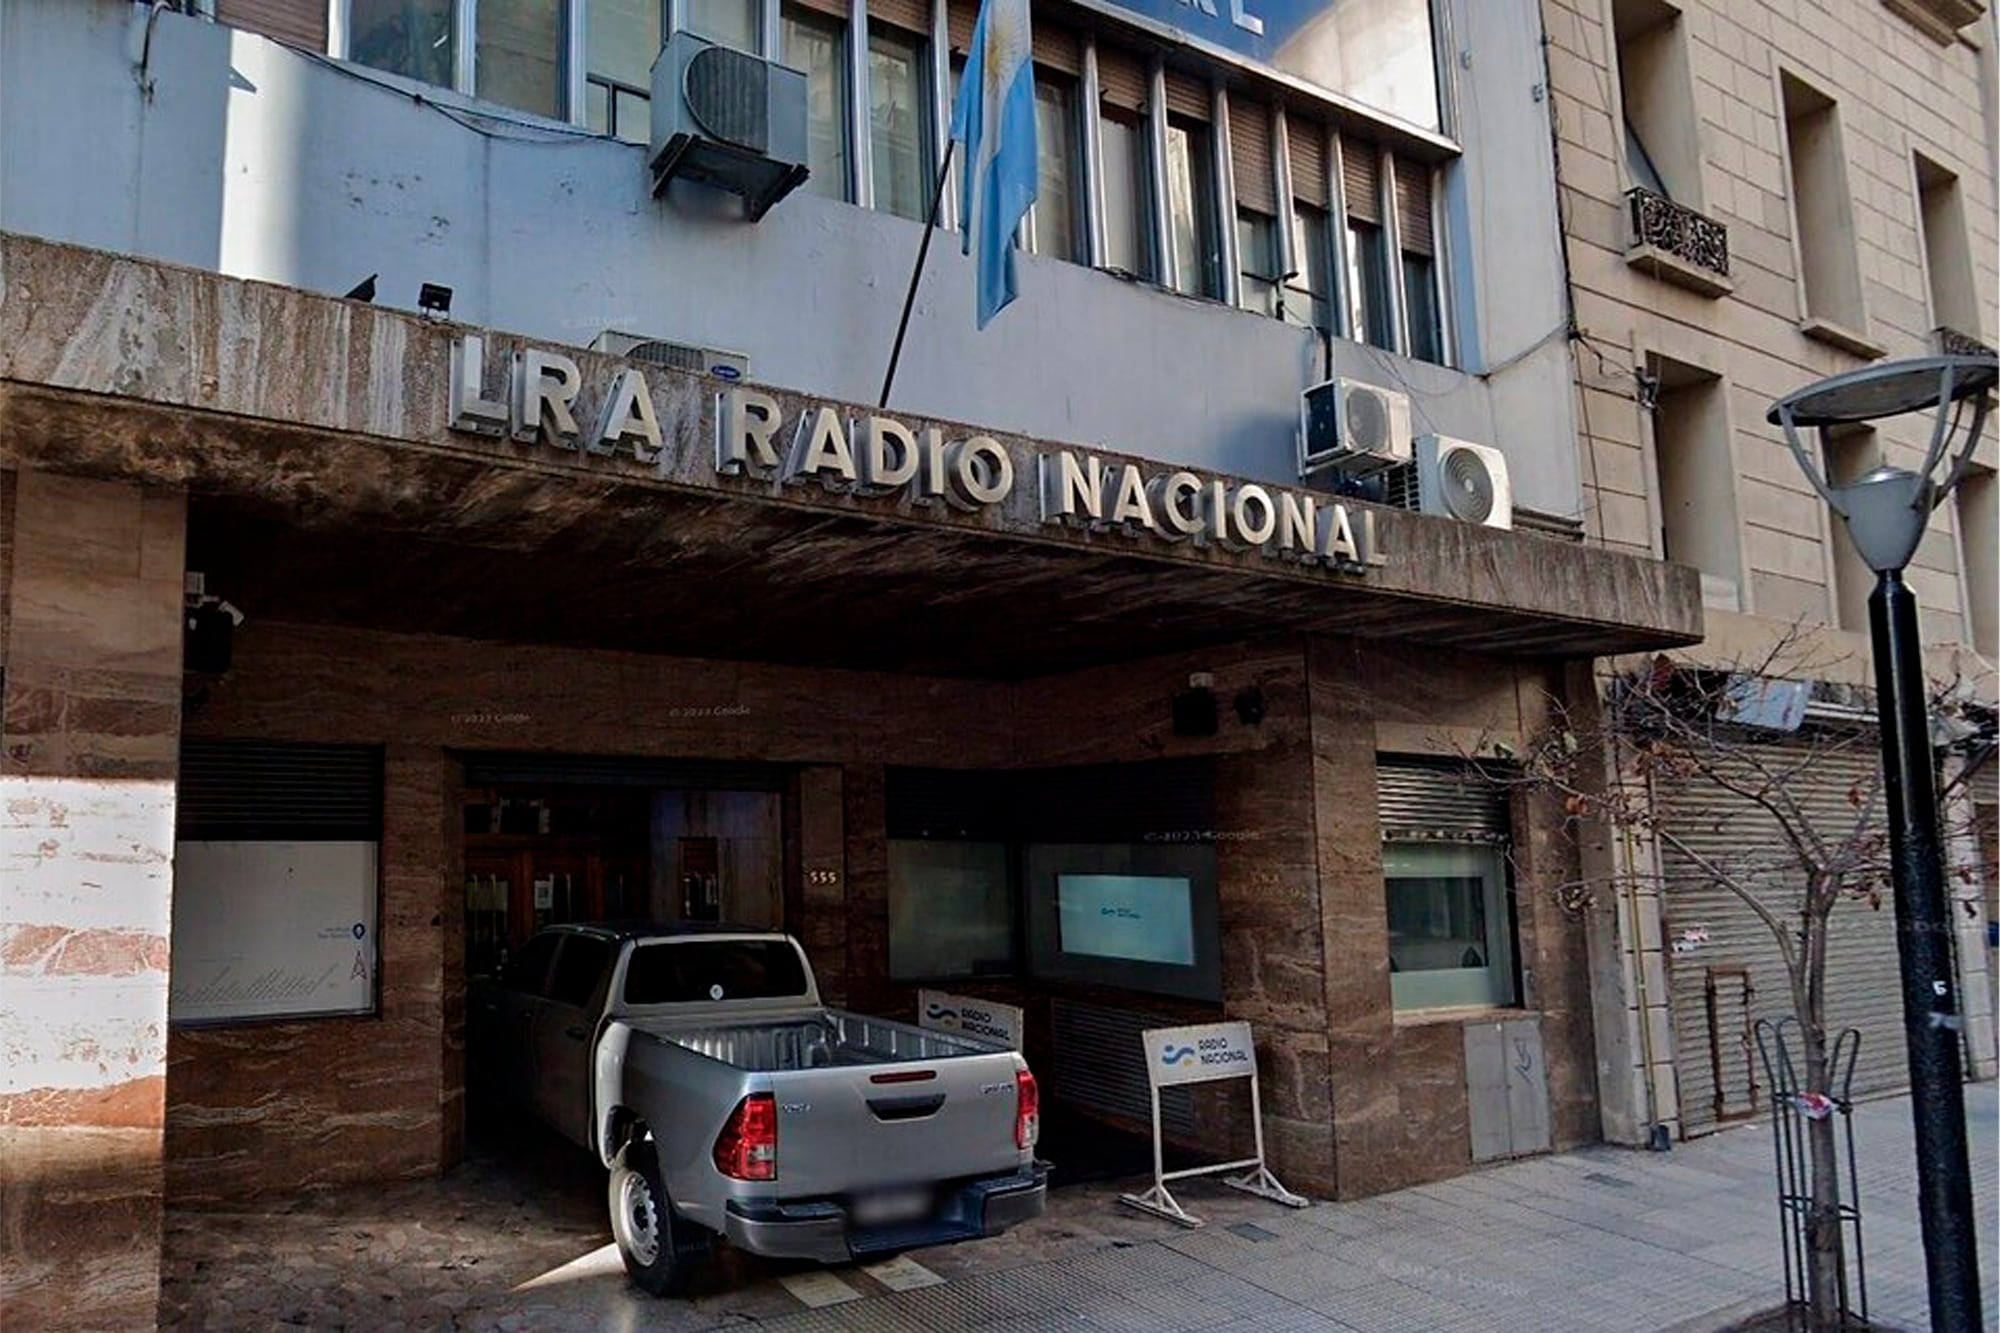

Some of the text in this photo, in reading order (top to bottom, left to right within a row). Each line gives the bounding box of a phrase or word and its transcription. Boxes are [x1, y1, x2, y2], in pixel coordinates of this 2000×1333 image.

[450, 334, 1388, 574] LRA RADIO NACIONAL
[961, 1007, 991, 1023] RADIO
[961, 1020, 1010, 1041] NACIONAL
[1199, 1037, 1227, 1050] RADIO
[1200, 1049, 1248, 1065] NACIONAL
